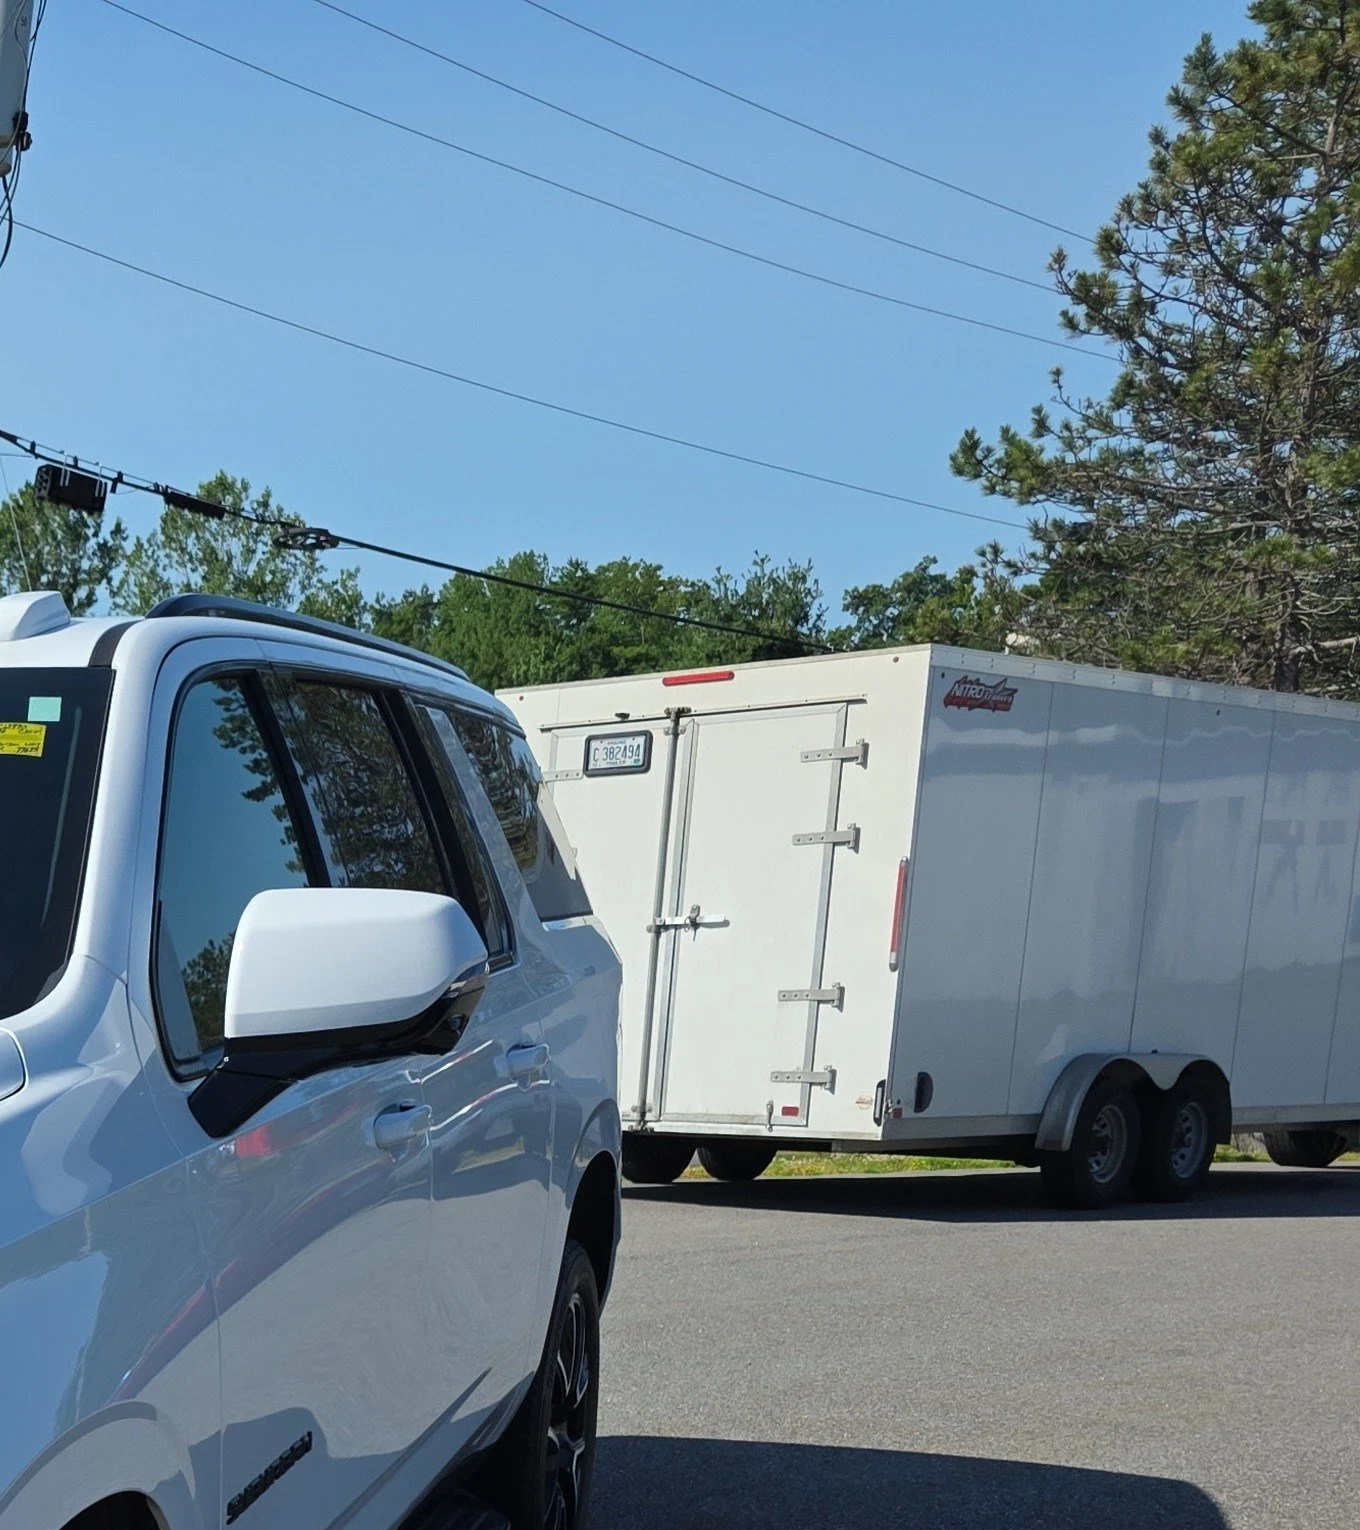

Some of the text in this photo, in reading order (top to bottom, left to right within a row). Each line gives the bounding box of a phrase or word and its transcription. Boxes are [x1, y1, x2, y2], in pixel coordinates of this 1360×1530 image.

[951, 683, 985, 699] NITRO
[593, 743, 641, 762] C 382494
